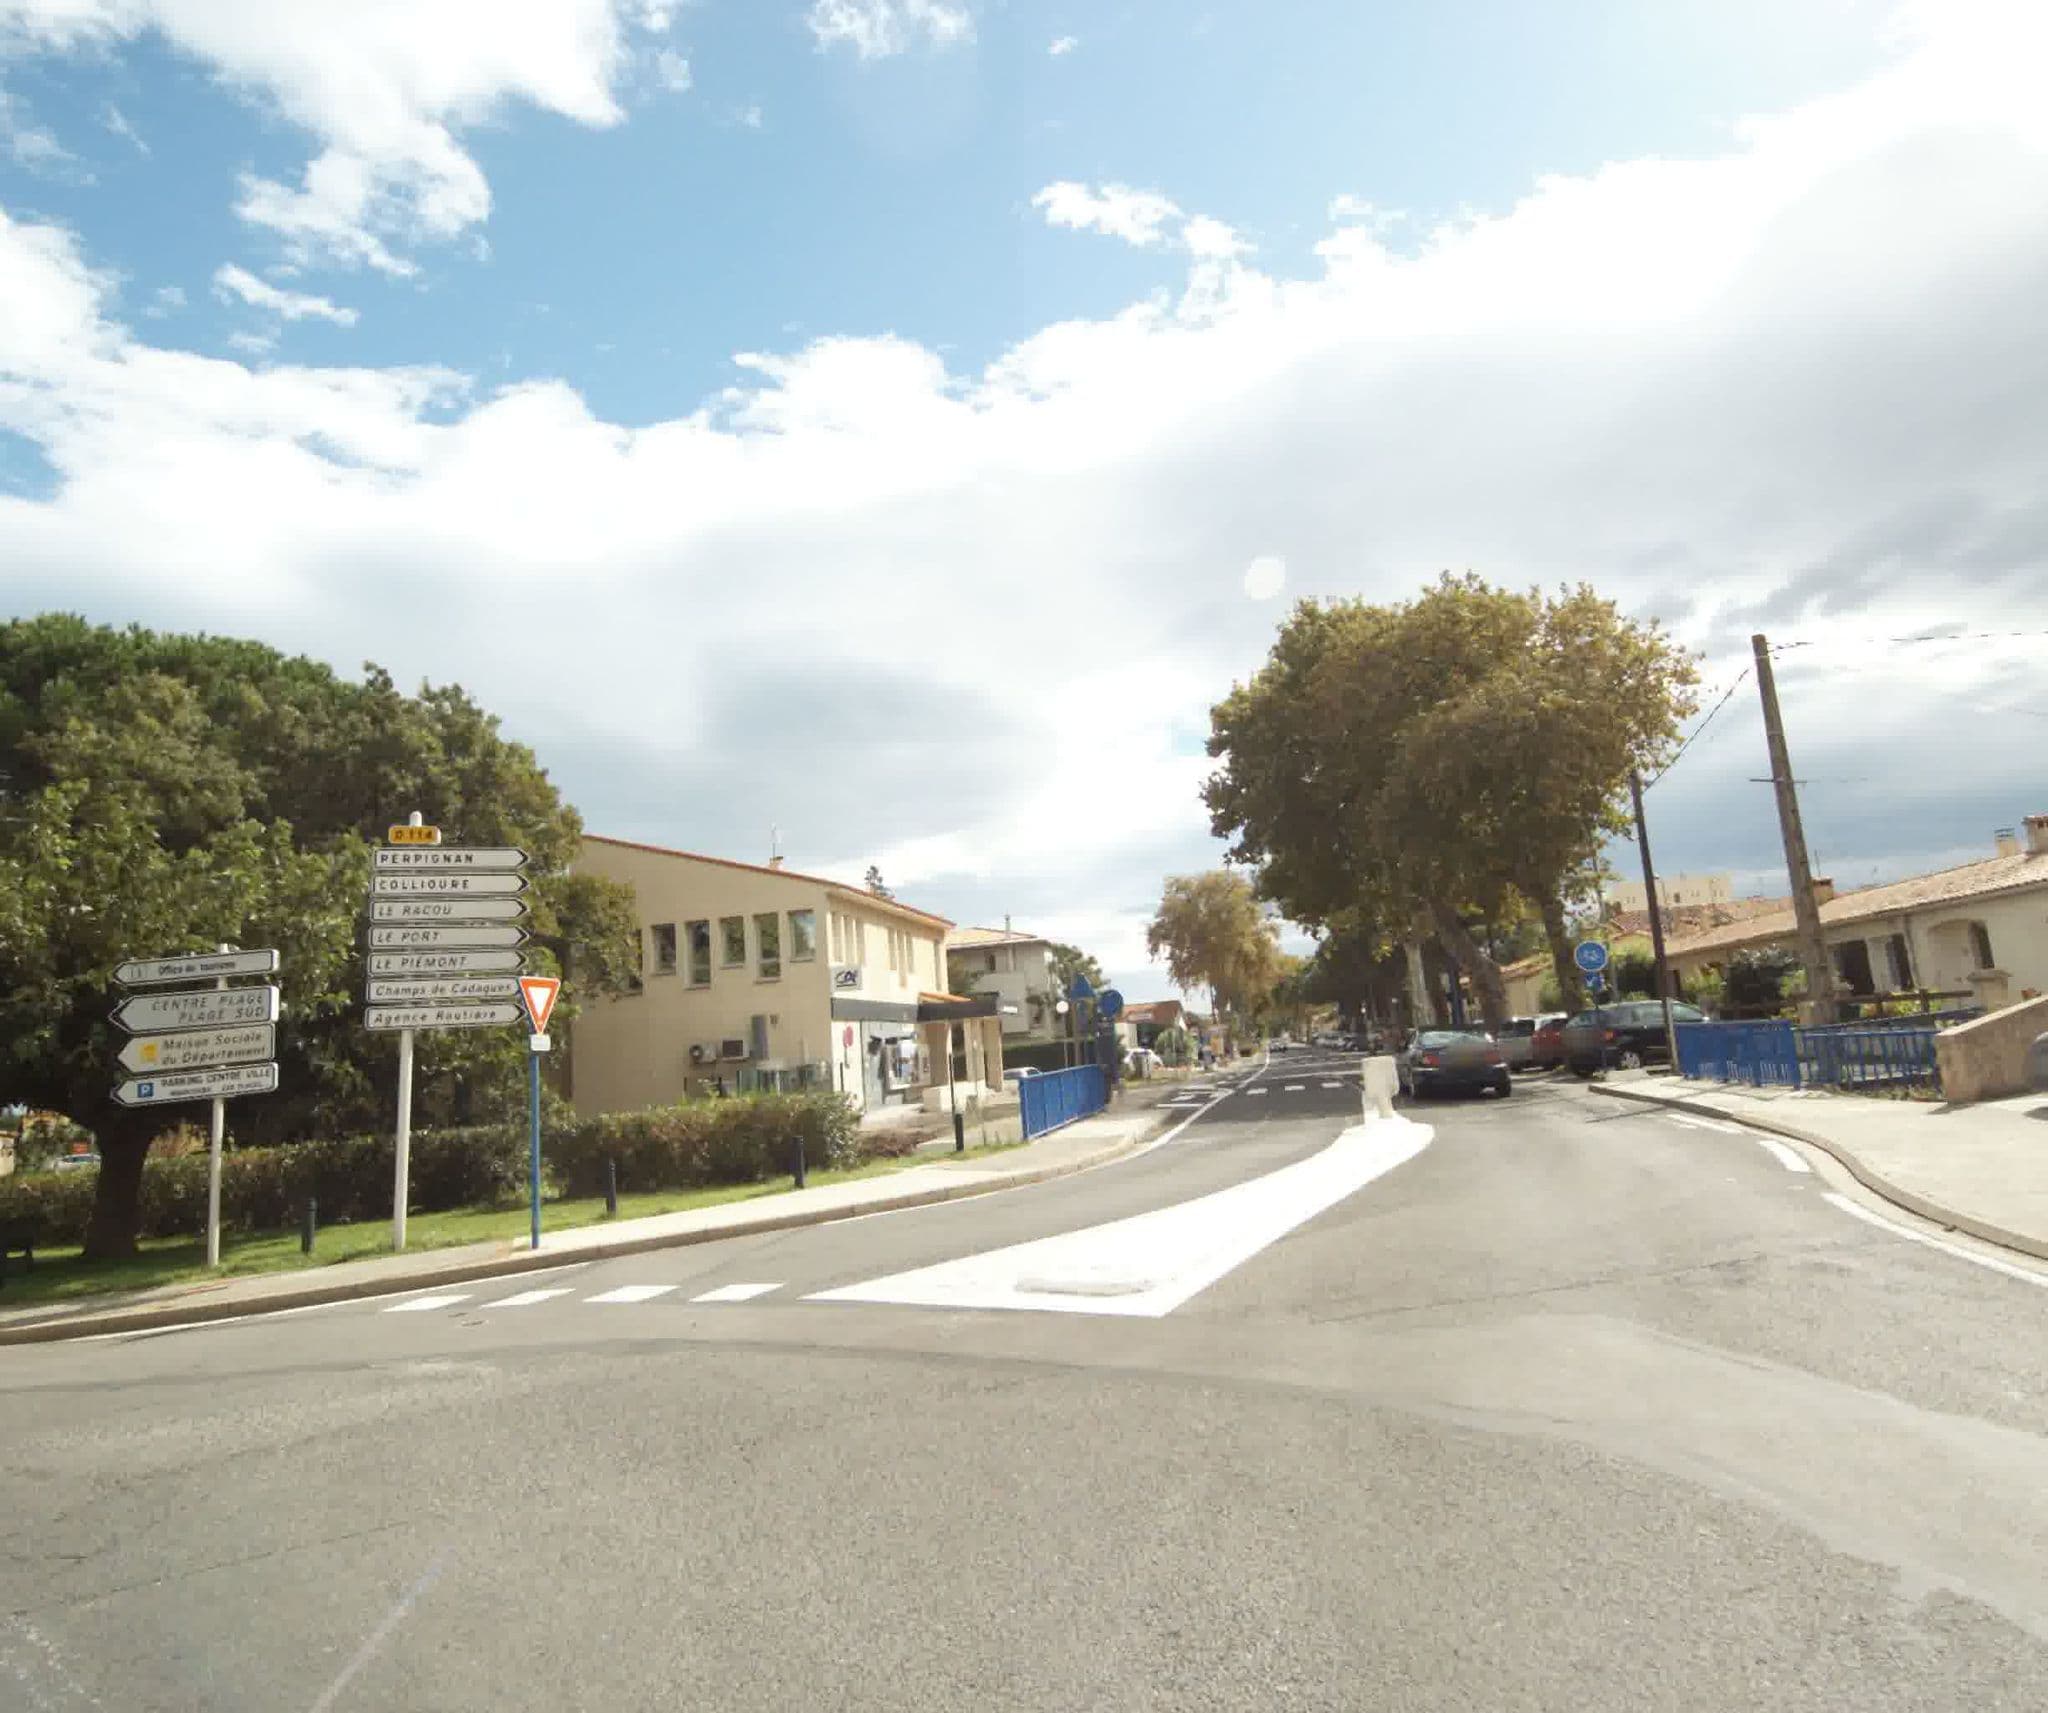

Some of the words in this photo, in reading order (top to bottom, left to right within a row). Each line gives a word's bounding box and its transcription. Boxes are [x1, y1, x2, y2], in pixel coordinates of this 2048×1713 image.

[380, 853, 475, 865] PERPIGNAN
[379, 879, 471, 890] COLLIOURE
[378, 905, 393, 917] LE
[402, 904, 453, 916] RACOU
[377, 932, 392, 943] LE
[401, 931, 441, 943] PORT
[375, 959, 391, 970] LE
[431, 984, 447, 994] de
[151, 997, 208, 1011] CENTRE
[218, 994, 264, 1006] PLAGE
[177, 1010, 225, 1024] PLAGE
[235, 1007, 264, 1018] SUD
[373, 1012, 428, 1026] Agence
[162, 1037, 209, 1050] Maison
[214, 1031, 262, 1045] Sociale
[162, 1054, 177, 1065] du
[161, 1075, 204, 1088] PARKING
[205, 1070, 242, 1083] CENTRE
[246, 1067, 270, 1079] VILLE
